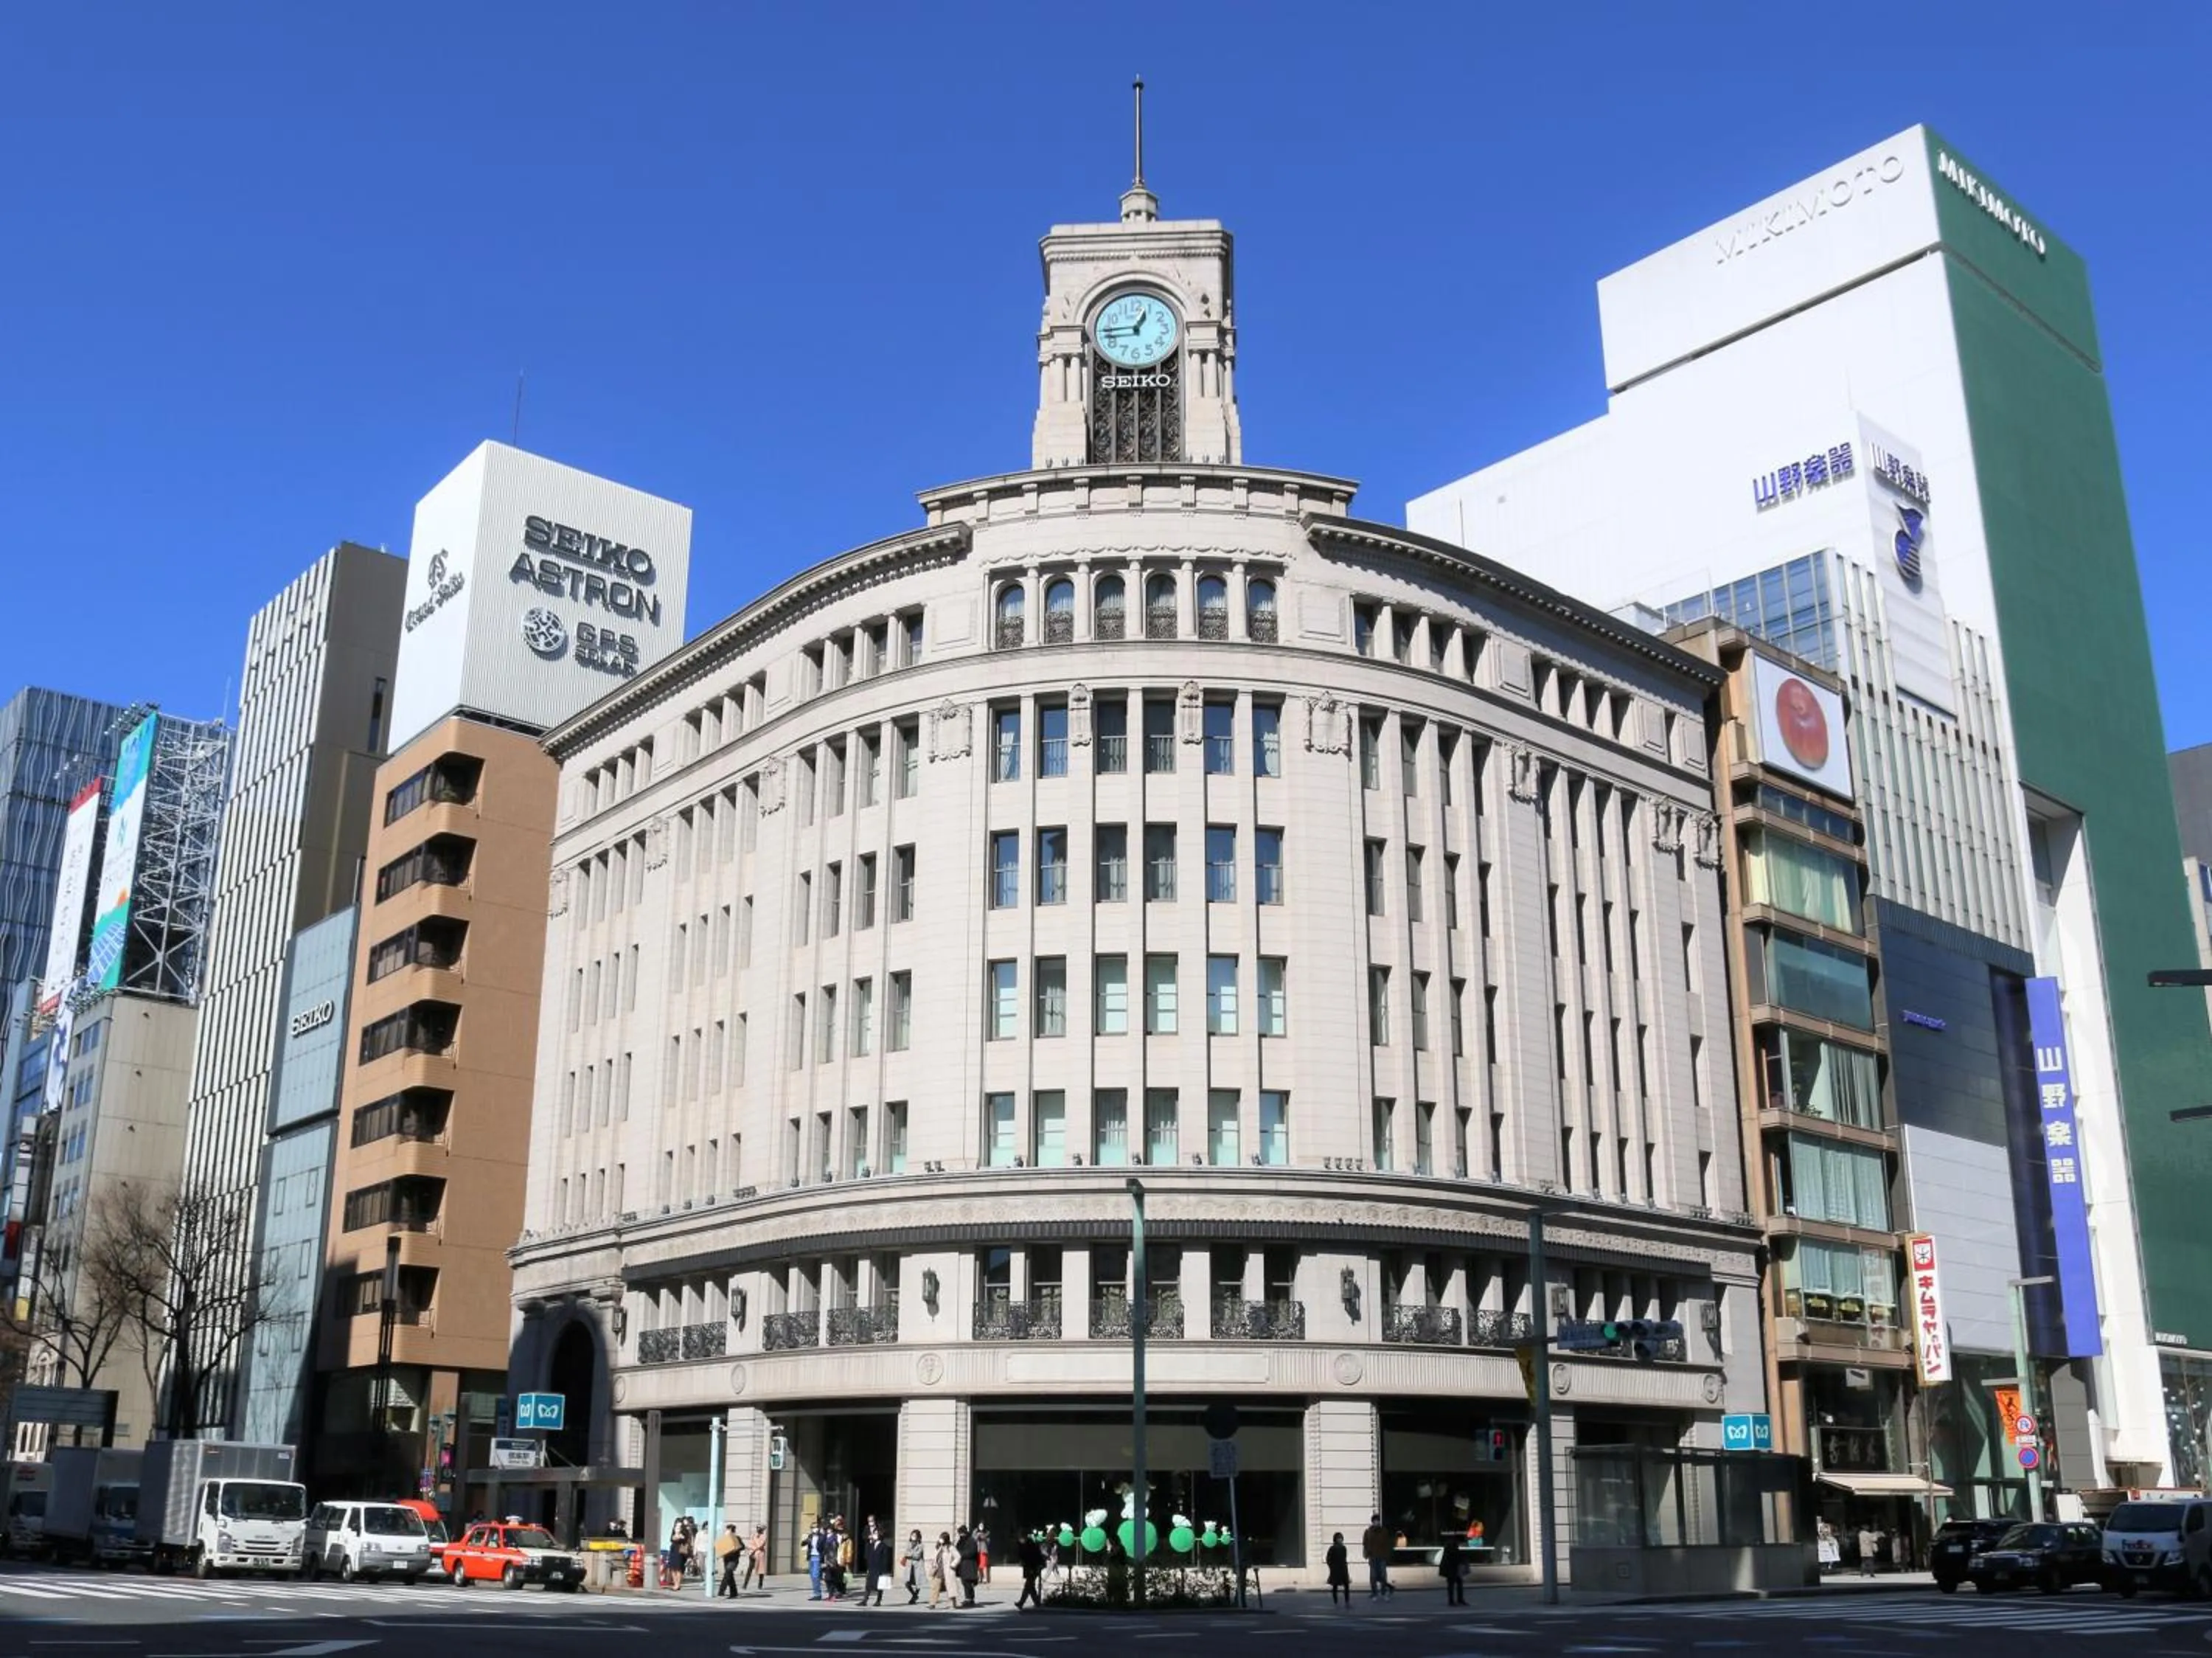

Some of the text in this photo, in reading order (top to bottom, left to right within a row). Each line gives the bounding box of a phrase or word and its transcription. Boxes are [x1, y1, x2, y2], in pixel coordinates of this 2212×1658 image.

[1938, 150, 2045, 254] MIKIMOTO
[1155, 311, 1164, 322] 2
[1161, 323, 1169, 335] 3
[1107, 336, 1117, 349] 8
[1119, 344, 1129, 356] 7
[1130, 347, 1141, 359] 6
[1144, 344, 1154, 355] 5
[1155, 336, 1165, 347] 4
[1102, 374, 1171, 389] SEIKO
[1753, 442, 1853, 505] 山野楽器
[524, 515, 654, 578] SEIKO
[509, 552, 659, 622] ASTRON
[577, 622, 636, 654] GPS
[291, 1001, 333, 1035] SEIKO
[2037, 1047, 2076, 1183] 山野楽器
[1919, 1275, 1941, 1375] キムラヤのパン
